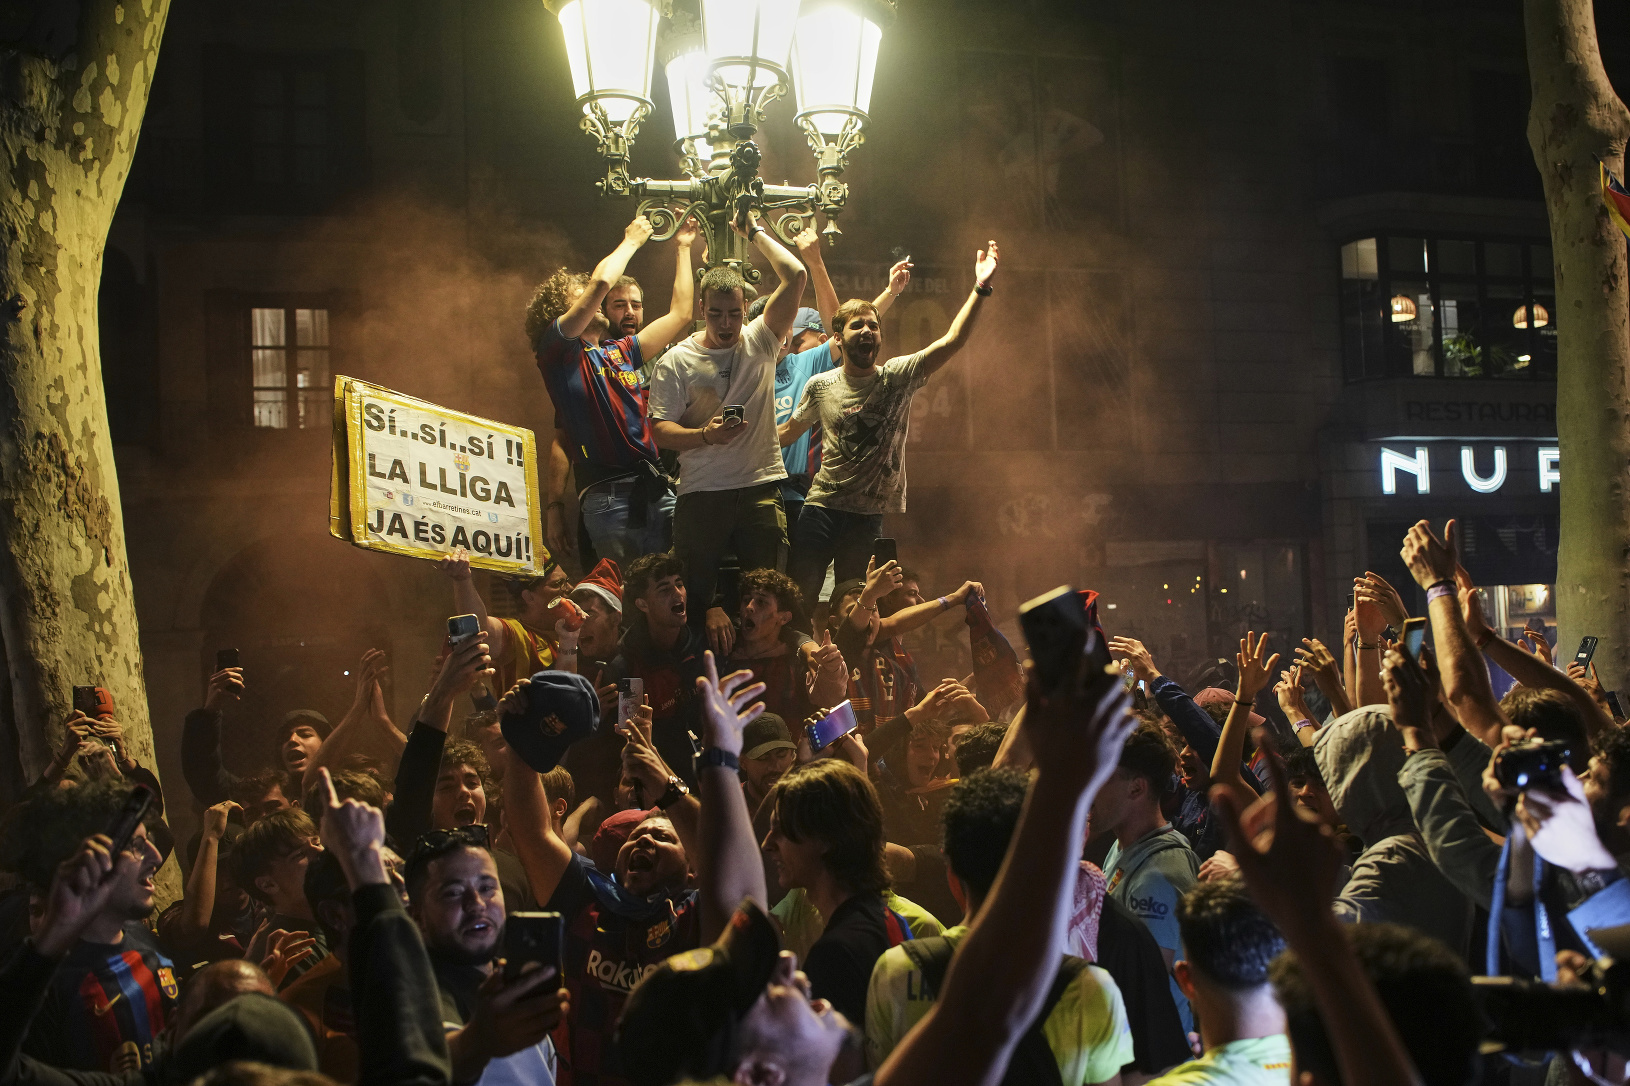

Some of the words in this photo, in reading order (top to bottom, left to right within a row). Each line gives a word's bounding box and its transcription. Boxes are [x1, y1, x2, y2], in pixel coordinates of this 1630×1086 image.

[368, 452, 410, 485] LA
[418, 462, 516, 508] LLIGA
[367, 508, 409, 540] JA
[413, 514, 446, 545] ÉS
[449, 525, 532, 562] AQUÍ!
[1130, 895, 1169, 916] beko
